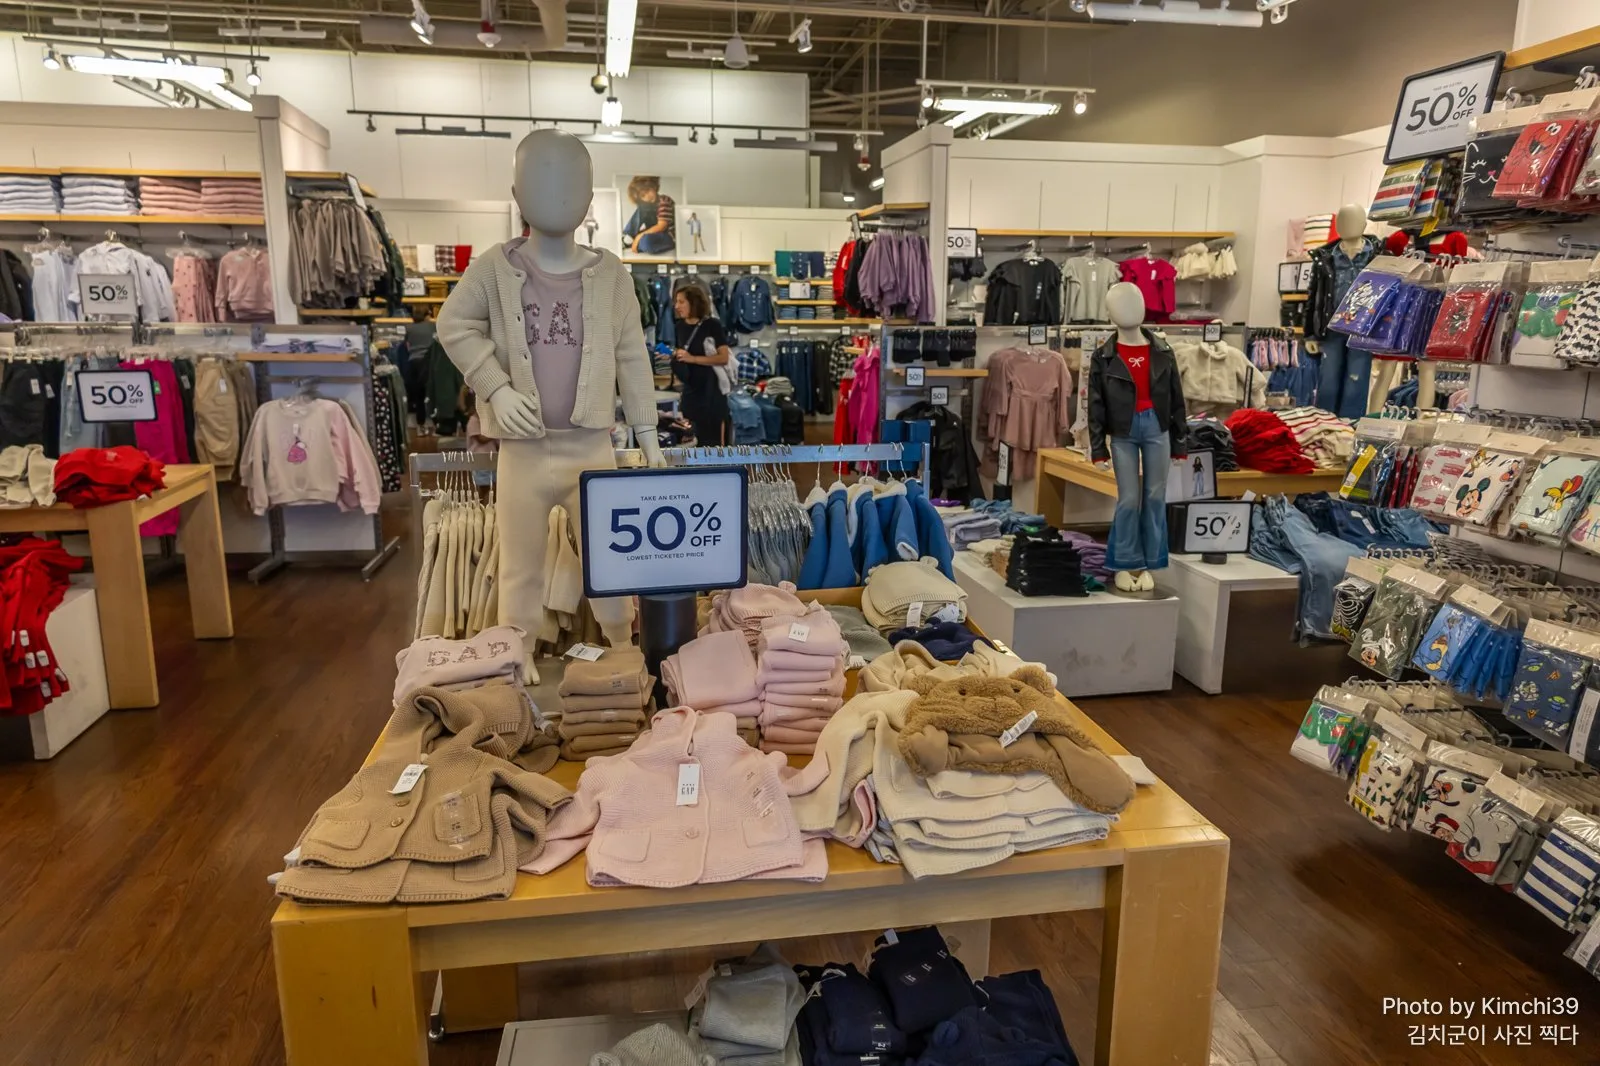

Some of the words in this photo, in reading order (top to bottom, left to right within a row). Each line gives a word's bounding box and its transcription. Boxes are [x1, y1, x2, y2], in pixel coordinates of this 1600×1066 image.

[1405, 83, 1478, 131] 50%
[1452, 108, 1474, 121] OFF
[89, 285, 128, 301] 50%
[91, 384, 144, 405] 50%
[608, 502, 722, 553] 50%
[690, 534, 722, 547] OFF
[427, 641, 511, 667] GAP
